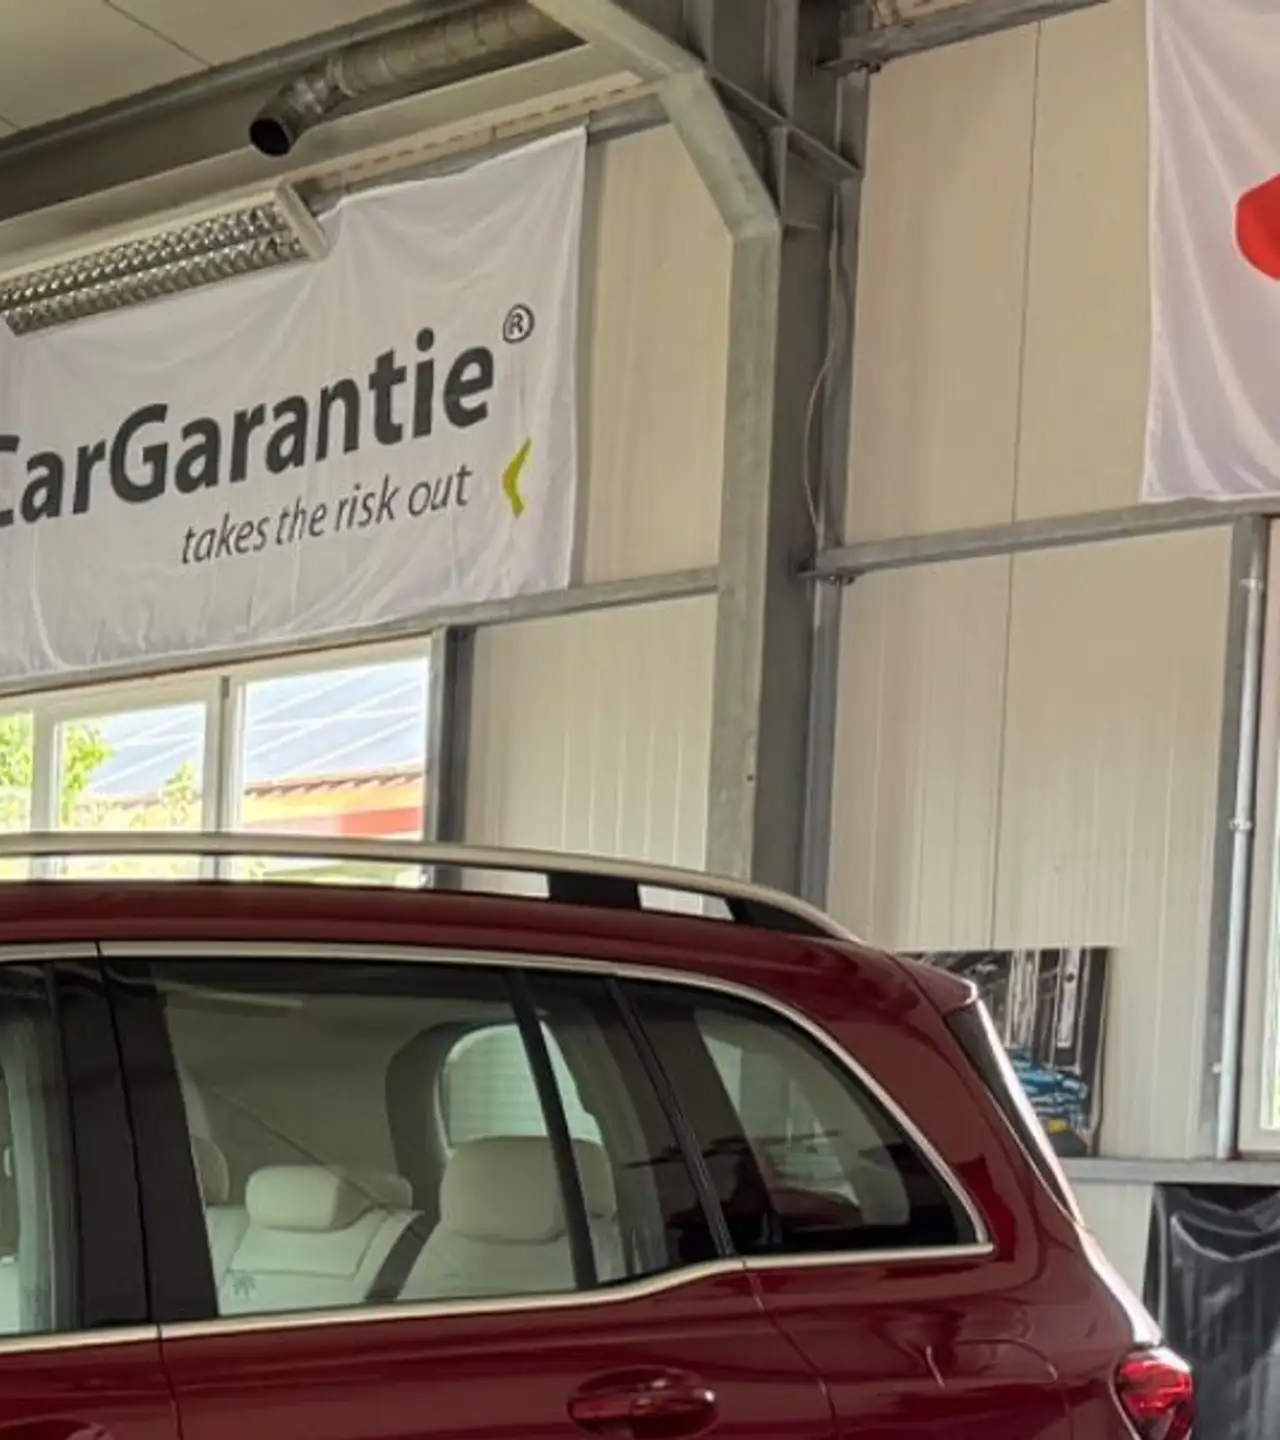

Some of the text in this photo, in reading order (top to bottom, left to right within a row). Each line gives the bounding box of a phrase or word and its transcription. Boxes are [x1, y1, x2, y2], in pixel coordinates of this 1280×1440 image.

[181, 463, 473, 565] takes the risk out
